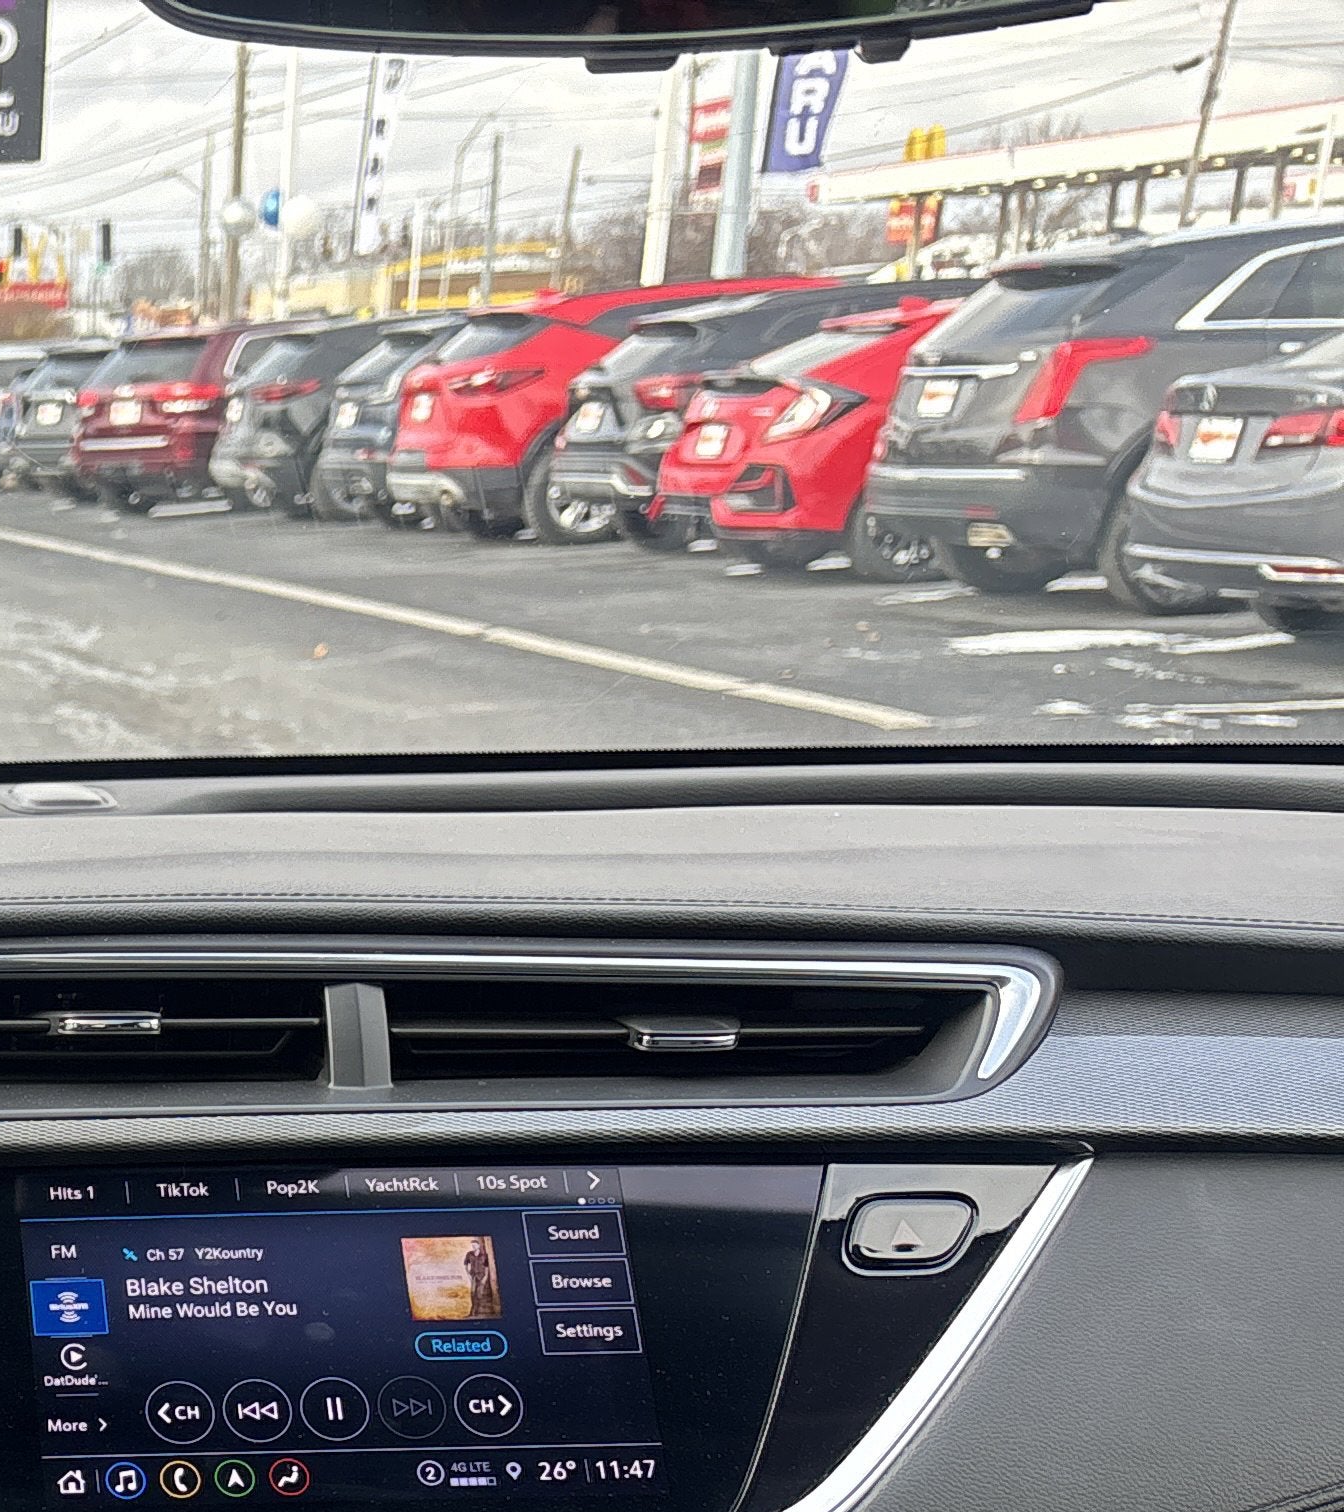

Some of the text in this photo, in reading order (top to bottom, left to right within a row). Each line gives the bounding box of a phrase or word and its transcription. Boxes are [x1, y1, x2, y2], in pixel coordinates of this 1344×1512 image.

[156, 1182, 210, 1198] TikTok
[266, 1180, 320, 1198] Pop2K
[365, 1177, 440, 1194] YachtRck
[476, 1175, 548, 1193] 10s Spot
[49, 1185, 95, 1201] Hits 1
[547, 1224, 600, 1241] Sound
[50, 1244, 77, 1260] FM
[146, 1248, 185, 1261] Ch 57
[194, 1247, 264, 1262] Y2Kountry
[125, 1275, 269, 1298] Blake Shelton
[551, 1274, 612, 1290] Browse
[128, 1300, 298, 1320] Mine Would Be You
[555, 1323, 624, 1341] Settings
[431, 1337, 492, 1353] Related
[174, 1405, 200, 1420] CH
[468, 1398, 494, 1414] CH
[47, 1418, 89, 1433] More
[424, 1466, 437, 1481] 2
[450, 1461, 492, 1473] 4G LTE
[595, 1459, 656, 1480] 11:47
